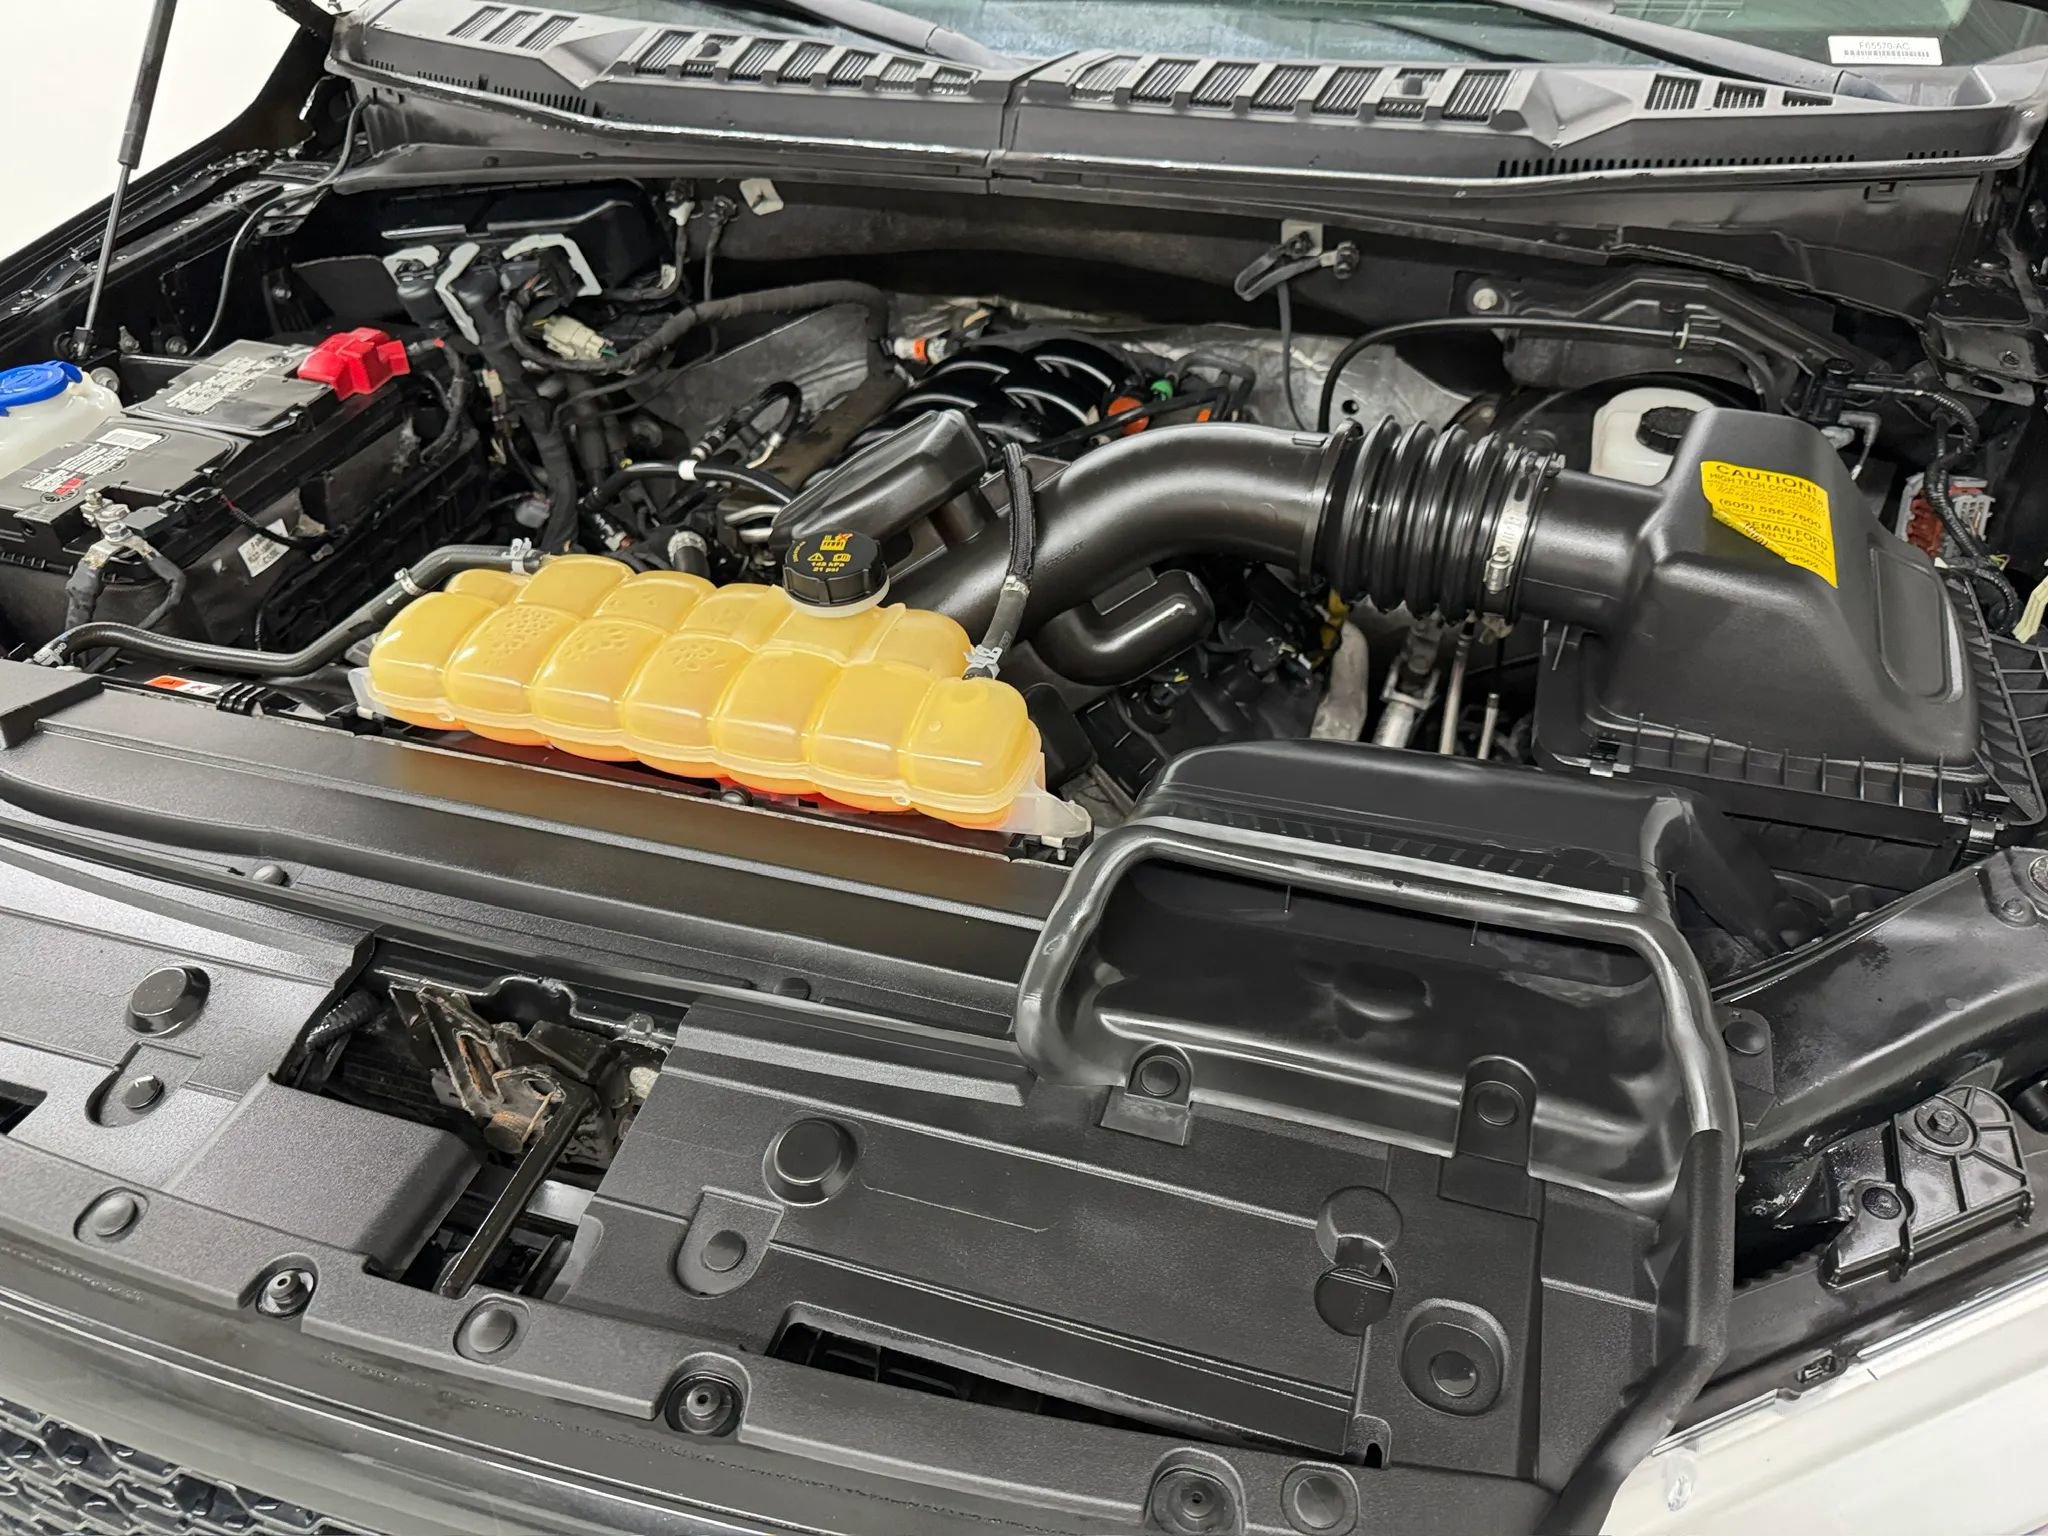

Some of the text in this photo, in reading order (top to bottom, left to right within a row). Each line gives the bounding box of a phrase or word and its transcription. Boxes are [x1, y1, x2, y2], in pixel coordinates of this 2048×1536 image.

[1709, 473, 1736, 485] HIGH
[1738, 479, 1766, 489] TECH
[1716, 465, 1817, 493] CAUTION!
[1719, 498, 1755, 511] (609)
[1796, 529, 1828, 550] FORD
